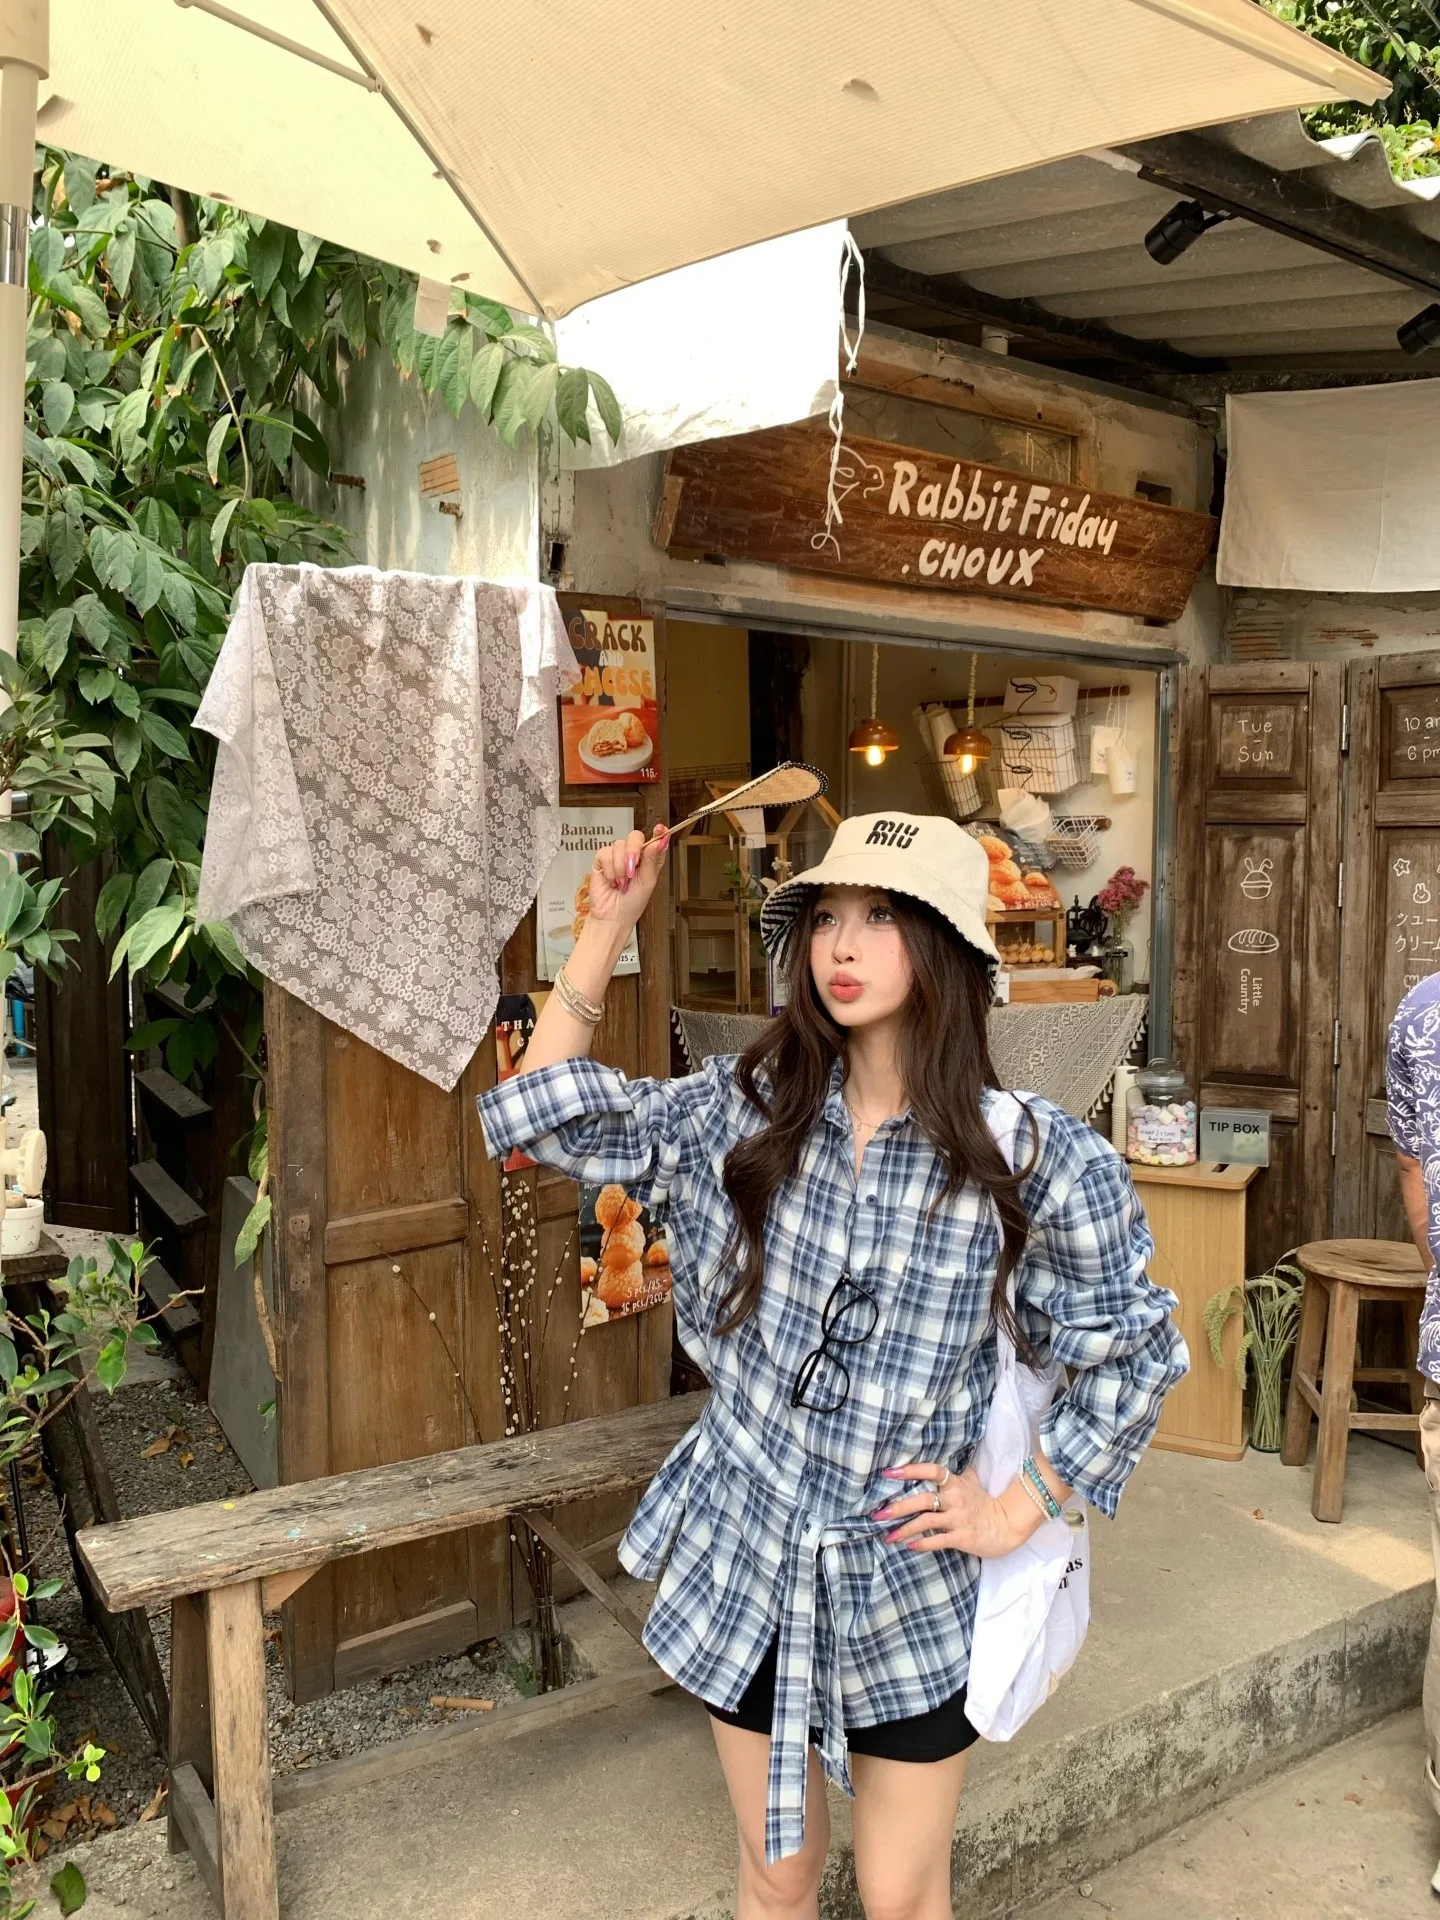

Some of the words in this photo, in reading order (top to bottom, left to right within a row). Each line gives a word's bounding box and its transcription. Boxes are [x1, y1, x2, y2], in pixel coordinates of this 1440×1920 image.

[888, 460, 1018, 532] Rabbit
[1018, 485, 1118, 555] Friday
[569, 617, 646, 652] CRACK
[1238, 720, 1272, 734] Tue
[1404, 717, 1420, 731] 10
[1238, 747, 1274, 762] Sun
[1407, 745, 1417, 760] 6
[561, 823, 613, 835] Banana
[1238, 968, 1250, 1015] Country
[1252, 977, 1263, 1006] Little
[1209, 1122, 1229, 1133] TIP
[1233, 1123, 1260, 1134] BOX
[627, 1287, 633, 1298] 5
